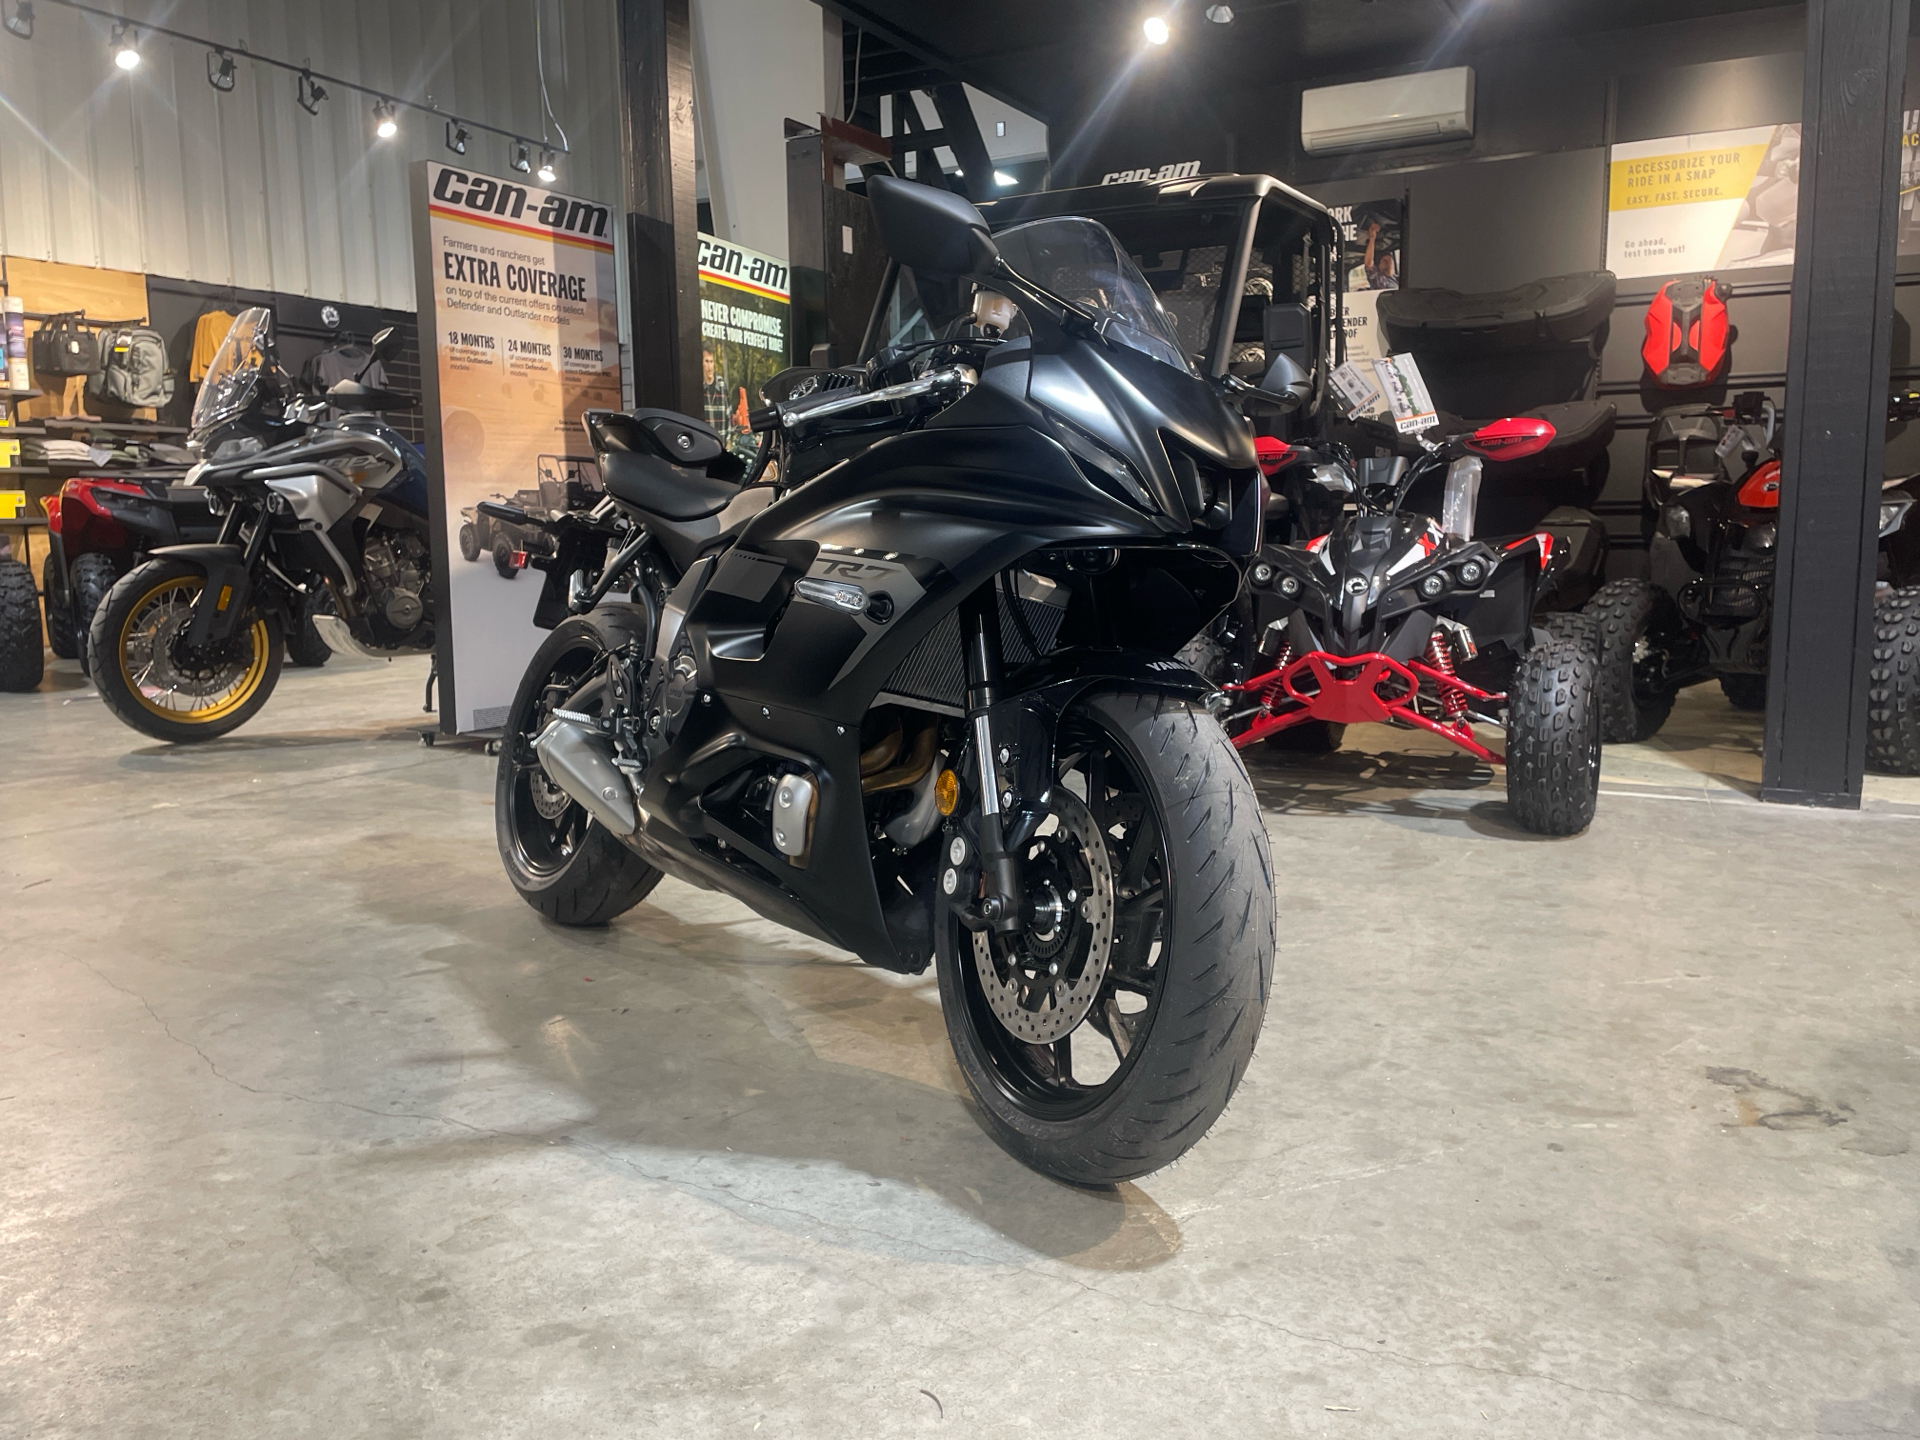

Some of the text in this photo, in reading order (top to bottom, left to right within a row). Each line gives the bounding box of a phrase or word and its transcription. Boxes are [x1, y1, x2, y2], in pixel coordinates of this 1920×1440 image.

[1101, 160, 1201, 186] can-am
[1628, 152, 1741, 175] ACCESSORIZE YOUR
[1627, 168, 1716, 188] RIDE IN A SNAP
[433, 168, 609, 238] can-am
[443, 236, 545, 266] Farmers and ranchers get
[698, 239, 788, 290] can-am
[444, 251, 588, 303] EXTRA COVERAGE
[445, 287, 585, 316] on top of the current offers on select
[446, 298, 571, 326] Defender and Outlander models
[700, 299, 729, 325] NEVER
[448, 331, 495, 350] 18 MONTHS
[508, 339, 552, 357] 24 MONTHS
[702, 321, 726, 340] CREATE
[743, 330, 768, 350] PERFECT
[563, 346, 604, 362] 30 MONTHS
